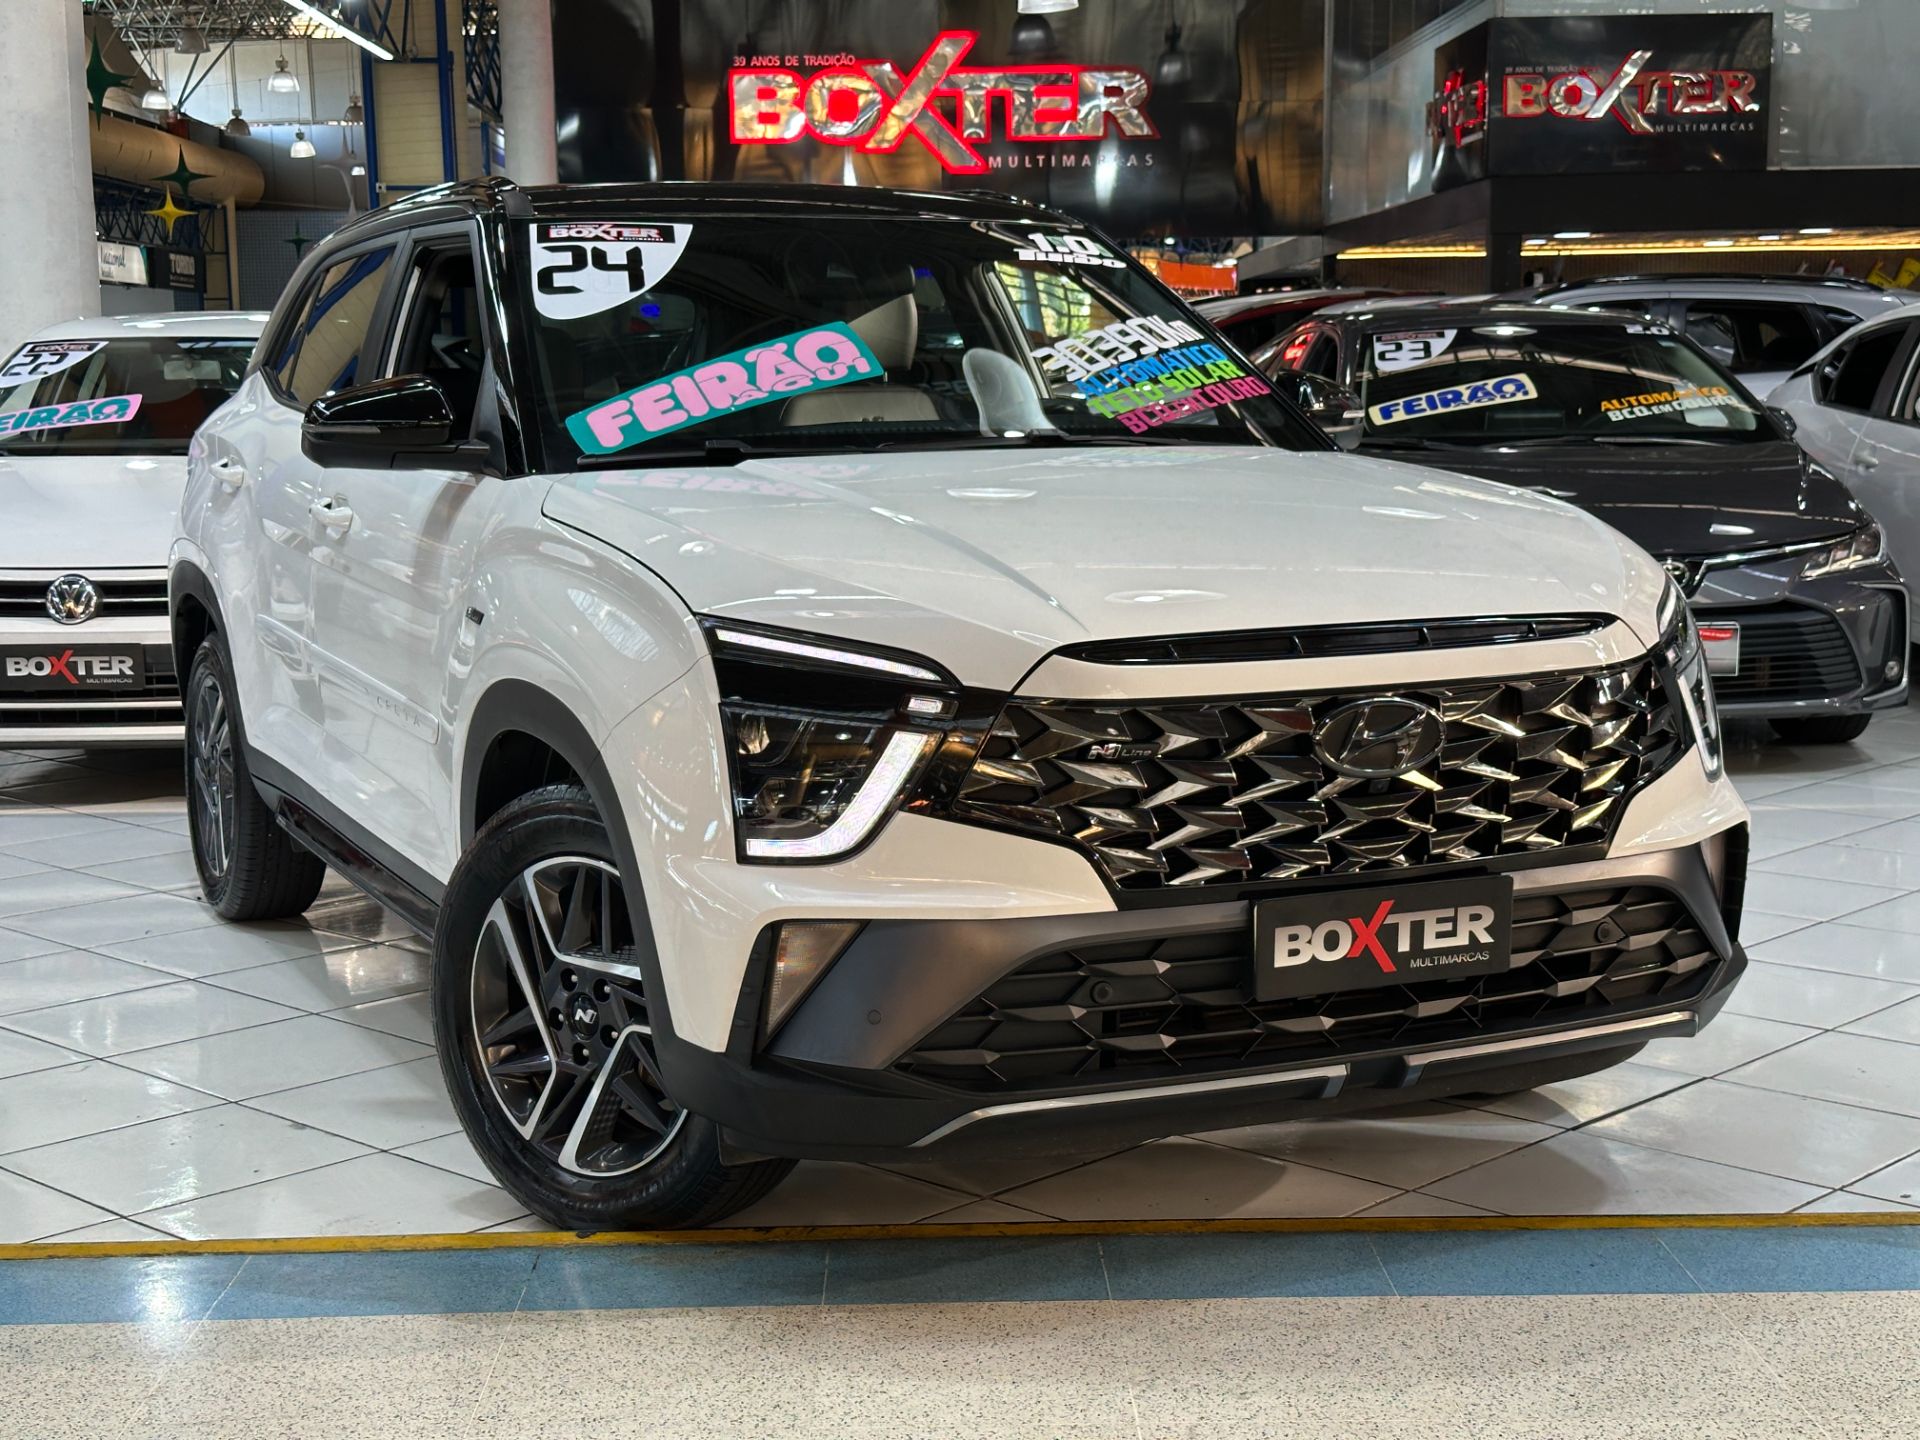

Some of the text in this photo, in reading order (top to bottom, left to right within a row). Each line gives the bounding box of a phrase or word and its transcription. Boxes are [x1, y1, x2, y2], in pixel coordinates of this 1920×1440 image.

[733, 52, 856, 67] 39 ANOS DE TRADIÇÃO
[728, 30, 1160, 175] BOXTER
[1503, 50, 1760, 134] BOXTER
[1655, 122, 1755, 132] MULTIMARCAS
[988, 153, 1155, 169] MULTIMARCAS
[549, 224, 661, 240] BOXTER
[1027, 233, 1100, 256] 1.0
[537, 245, 646, 295] 24
[1, 353, 69, 377] 22
[1378, 340, 1432, 361] 23
[586, 331, 861, 447] FEIRÃO
[1086, 361, 1246, 419] TETO SOLAR
[1379, 378, 1527, 421] FEIRÃO
[0, 398, 131, 432] EIRÃO
[5, 649, 135, 684] BOXTER
[1121, 748, 1152, 757] Line
[1273, 900, 1496, 973] BOXTER
[1410, 950, 1490, 969] MULTIMARCAS
